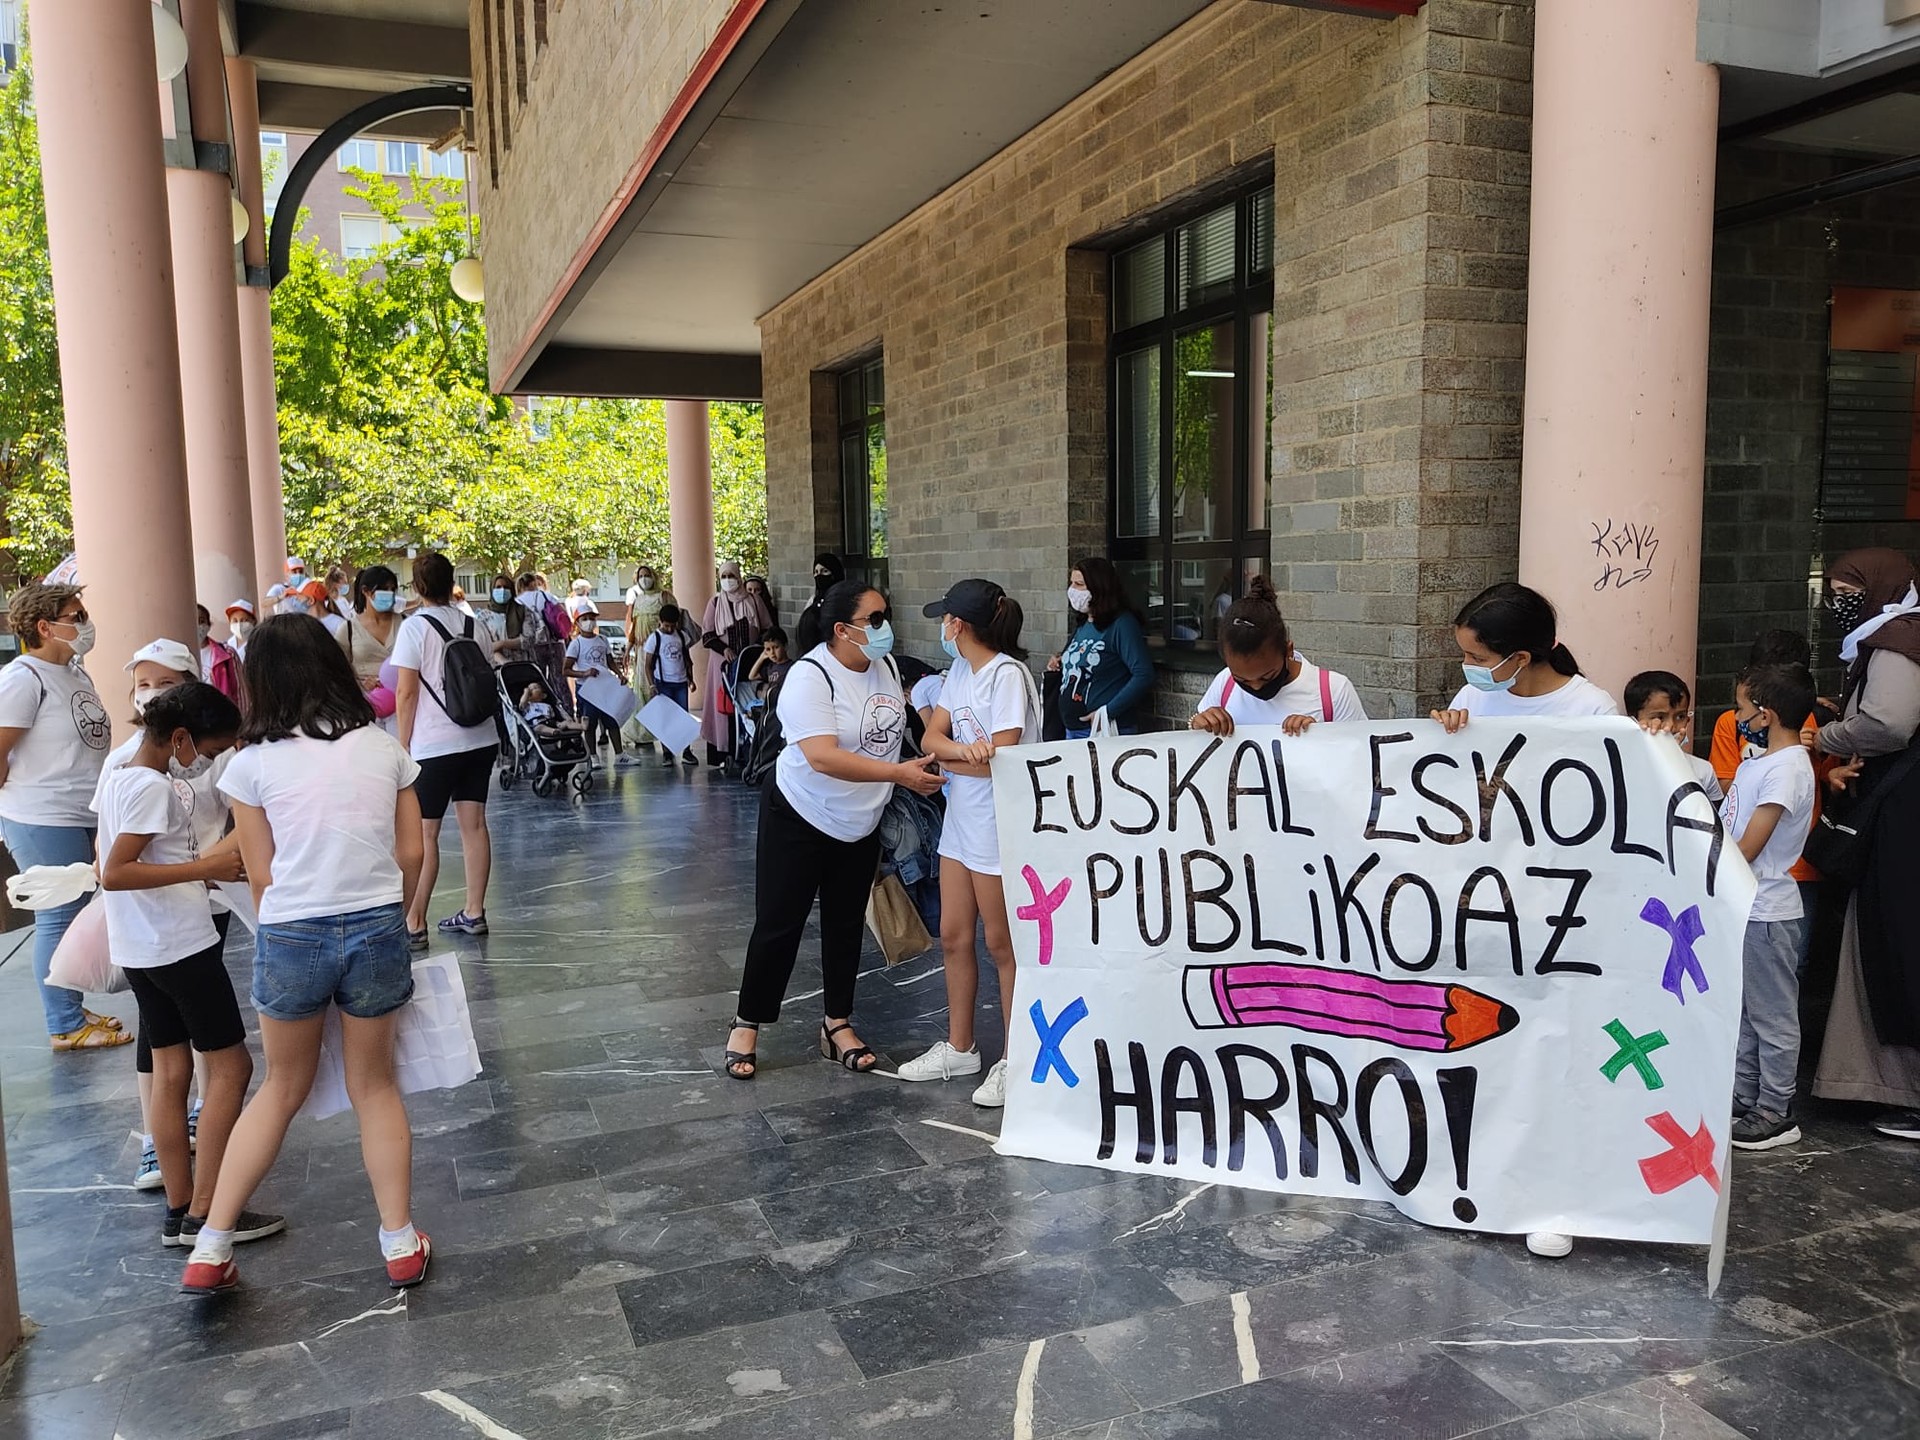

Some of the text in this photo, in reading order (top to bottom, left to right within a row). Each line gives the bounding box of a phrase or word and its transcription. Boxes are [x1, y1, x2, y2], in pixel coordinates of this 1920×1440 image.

[1026, 731, 1726, 898] EUSKAL ESKOLA
[1094, 1038, 1479, 1225] HARRO!
